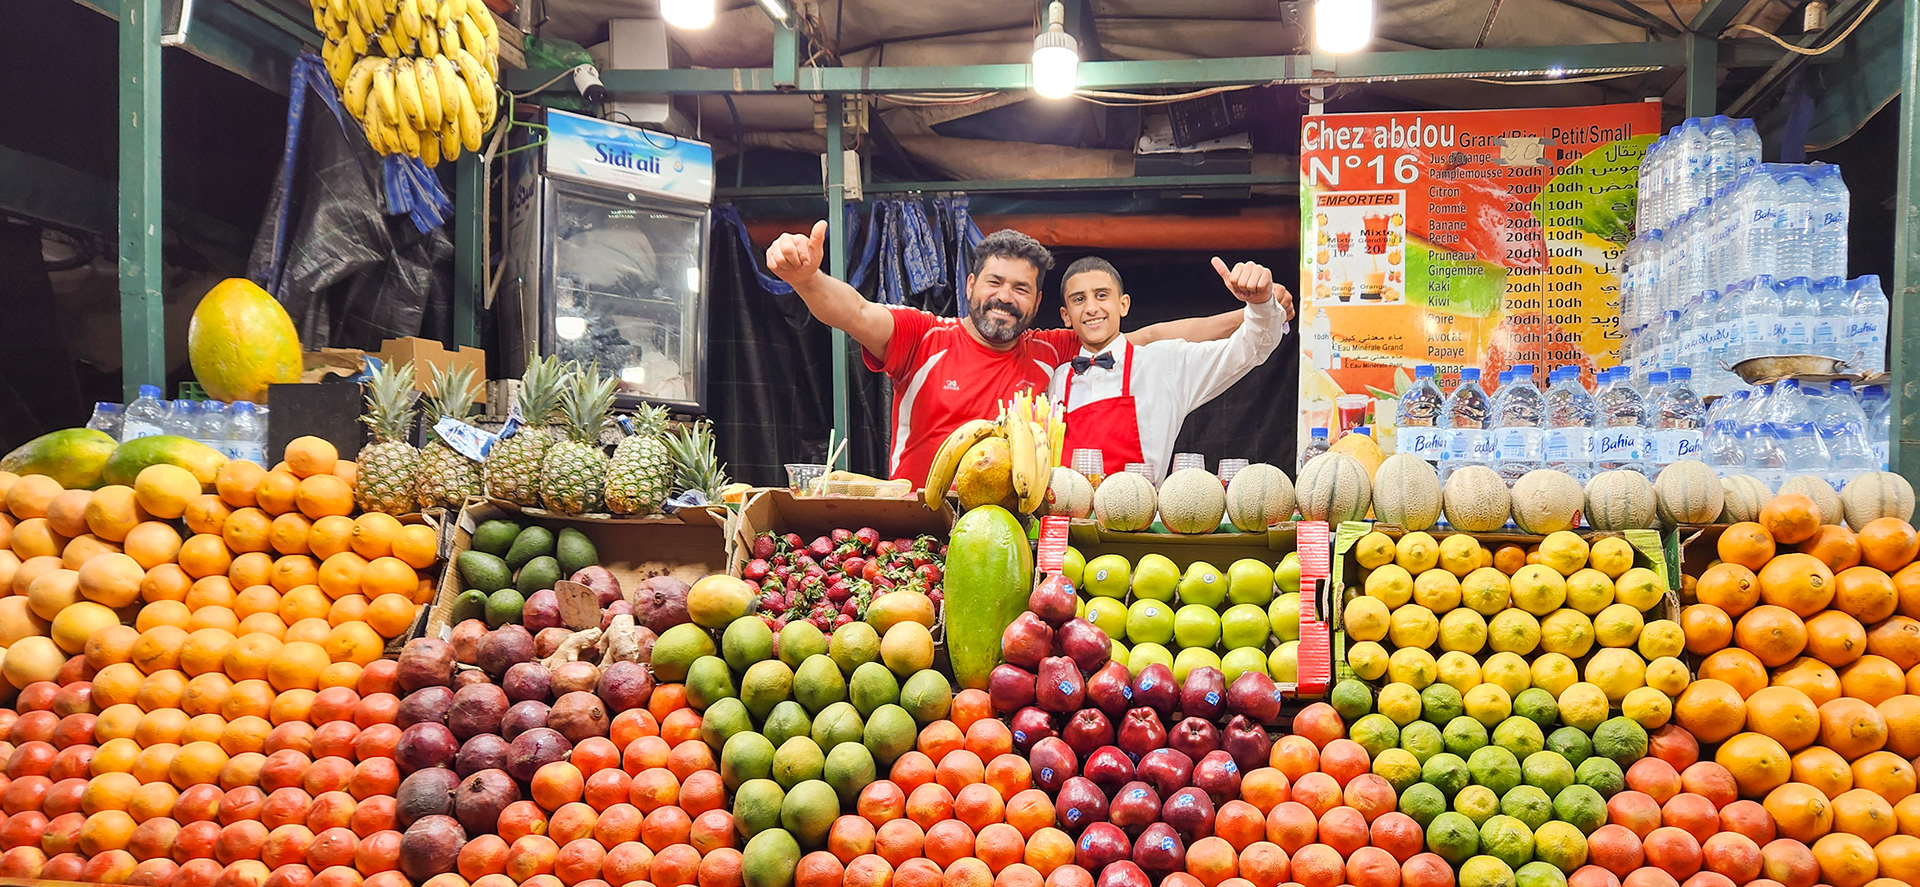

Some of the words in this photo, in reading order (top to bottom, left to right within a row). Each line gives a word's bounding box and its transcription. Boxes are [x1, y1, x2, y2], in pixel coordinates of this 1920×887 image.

[1302, 120, 1365, 151] Chez
[1373, 117, 1455, 149] abdou
[1551, 123, 1632, 145] Petit/Small
[594, 143, 632, 168] Sidi
[636, 155, 660, 174] ali
[1429, 153, 1446, 164] Jus
[1309, 153, 1420, 186] N°16
[1429, 168, 1503, 182] Pamplemousse
[1507, 167, 1541, 178] 20dh
[1549, 165, 1583, 176] 10dh
[1429, 186, 1460, 197] Citron
[1507, 184, 1541, 194] 20dh
[1548, 182, 1583, 193] 10dh
[1317, 194, 1394, 206] EMPORTER
[1429, 203, 1467, 214] Pomme
[1506, 201, 1541, 212] 20dh
[1548, 200, 1583, 211] 10dh
[1429, 220, 1467, 231] Banane
[1506, 218, 1541, 229] 20dh
[1548, 216, 1583, 227] 10dh
[1429, 233, 1459, 244] Peche
[1506, 231, 1541, 242] 20dh
[1548, 230, 1583, 241] 10dh
[1428, 250, 1477, 261] Pruneaux
[1506, 249, 1541, 259] 20dh
[1547, 247, 1582, 258] 10dh
[1428, 264, 1484, 278] Gingembre
[1506, 266, 1540, 277] 20dh
[1547, 265, 1582, 276] 10dh
[1428, 281, 1450, 292] Kaki
[1506, 283, 1540, 293] 20dh
[1547, 281, 1582, 292] 10dh
[1428, 296, 1450, 307] Kiwi
[1506, 299, 1540, 309] 20dh
[1547, 298, 1582, 309] 10dh
[1506, 315, 1540, 325] 20dh
[1547, 313, 1582, 324] 10dh
[1850, 321, 1877, 337] Bahia
[1547, 331, 1582, 343] 10dh
[1337, 344, 1351, 352] Eau
[1352, 343, 1381, 352] Minérale
[1382, 343, 1404, 351] Grand
[1428, 346, 1464, 359] Papaye
[1505, 350, 1540, 361] 20dh
[1547, 349, 1582, 360] 10dh
[1430, 363, 1465, 374] nanas
[1601, 433, 1635, 454] Bahia
